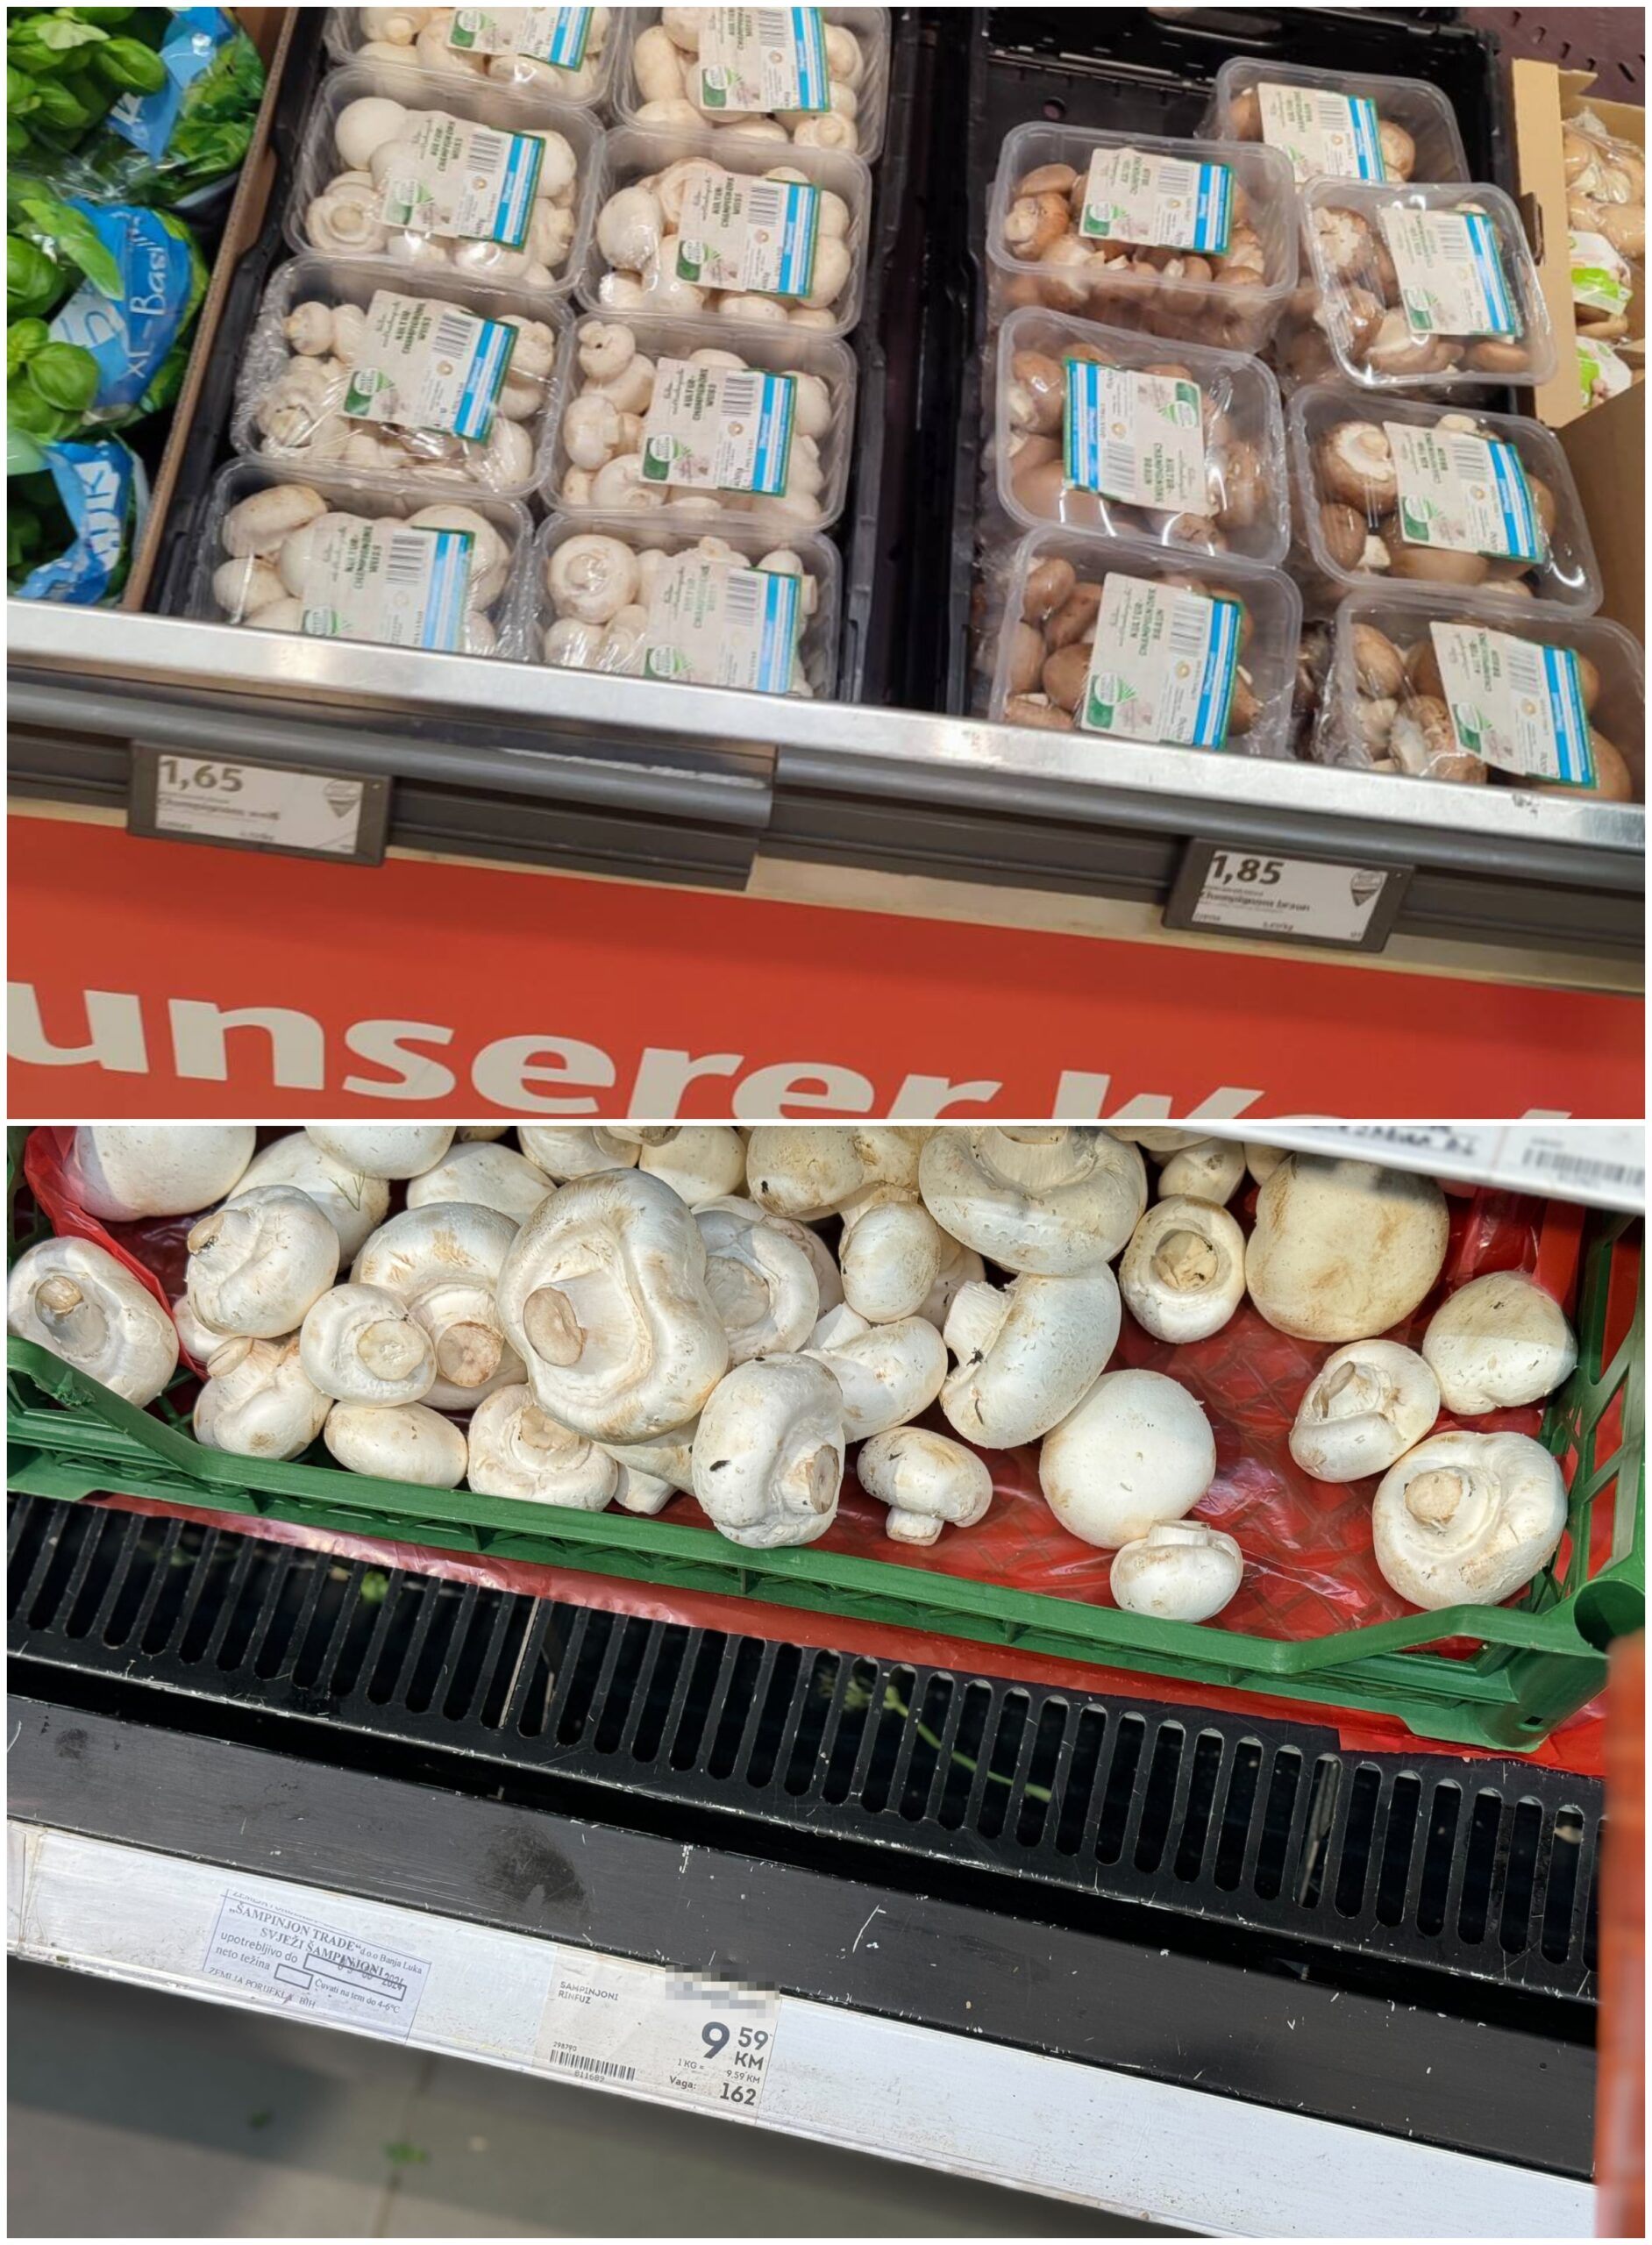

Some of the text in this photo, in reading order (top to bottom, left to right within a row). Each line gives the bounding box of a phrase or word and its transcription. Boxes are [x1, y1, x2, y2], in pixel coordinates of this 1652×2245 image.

[160, 759, 244, 792] 1,65
[1213, 855, 1284, 885] 1,85
[7, 981, 1002, 1119] unserer
[221, 1930, 283, 1959] upotrebljivo
[284, 1952, 298, 1963] do
[260, 1928, 304, 1950] SVJEŽI
[216, 1944, 271, 1971] neto težina
[380, 1953, 401, 1968] Banja
[402, 1961, 423, 1975] Luka
[315, 1978, 338, 1998] Čuvati
[340, 1988, 350, 1998] na
[351, 1989, 365, 2002] tem
[367, 1994, 377, 2006] do
[558, 1990, 591, 2005] RINFUZ
[559, 1981, 619, 2002] SAMPINJONI
[701, 2021, 769, 2059] 9 59
[683, 2060, 697, 2070] KG
[746, 2074, 760, 2084] KM
[734, 2051, 764, 2070] KM
[669, 2076, 757, 2106] Vaga: 162
